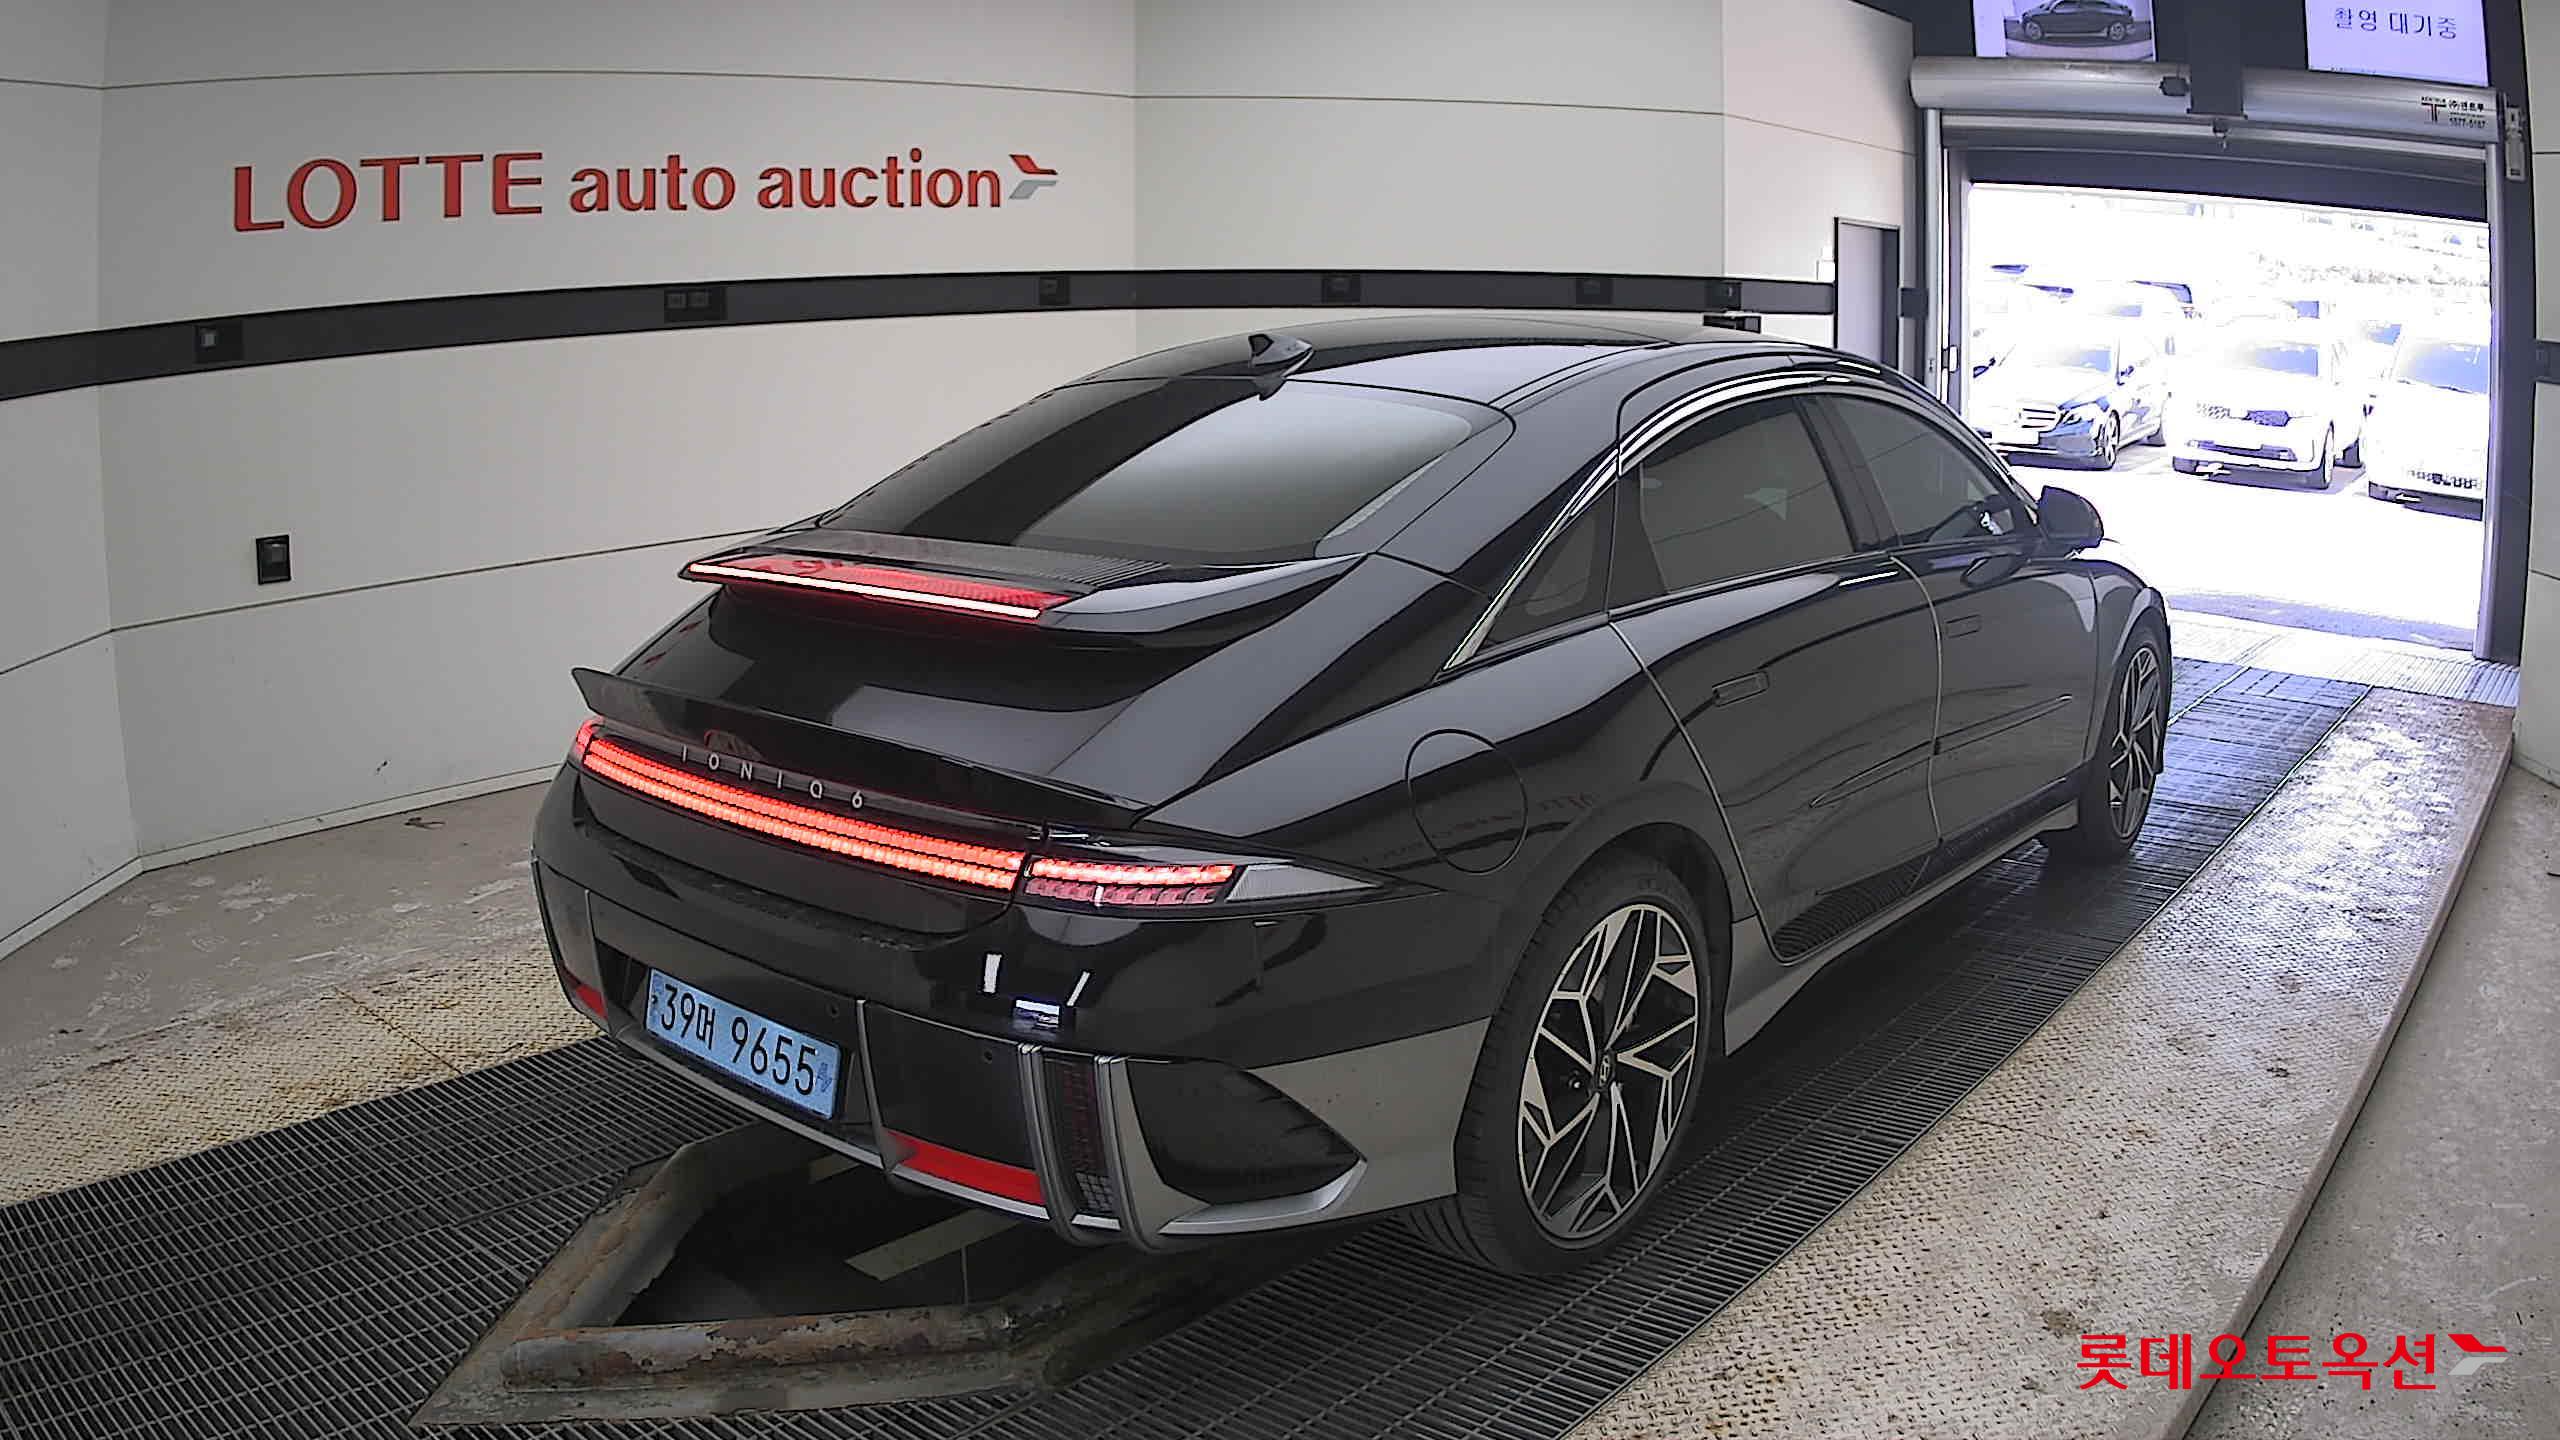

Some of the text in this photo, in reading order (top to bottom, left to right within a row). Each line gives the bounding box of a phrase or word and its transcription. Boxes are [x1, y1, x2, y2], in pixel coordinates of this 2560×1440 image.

[2335, 7, 2457, 40] 촬영 대기중
[233, 147, 1001, 232] LOTTE auto auction
[661, 983, 817, 1096] 39머 9655
